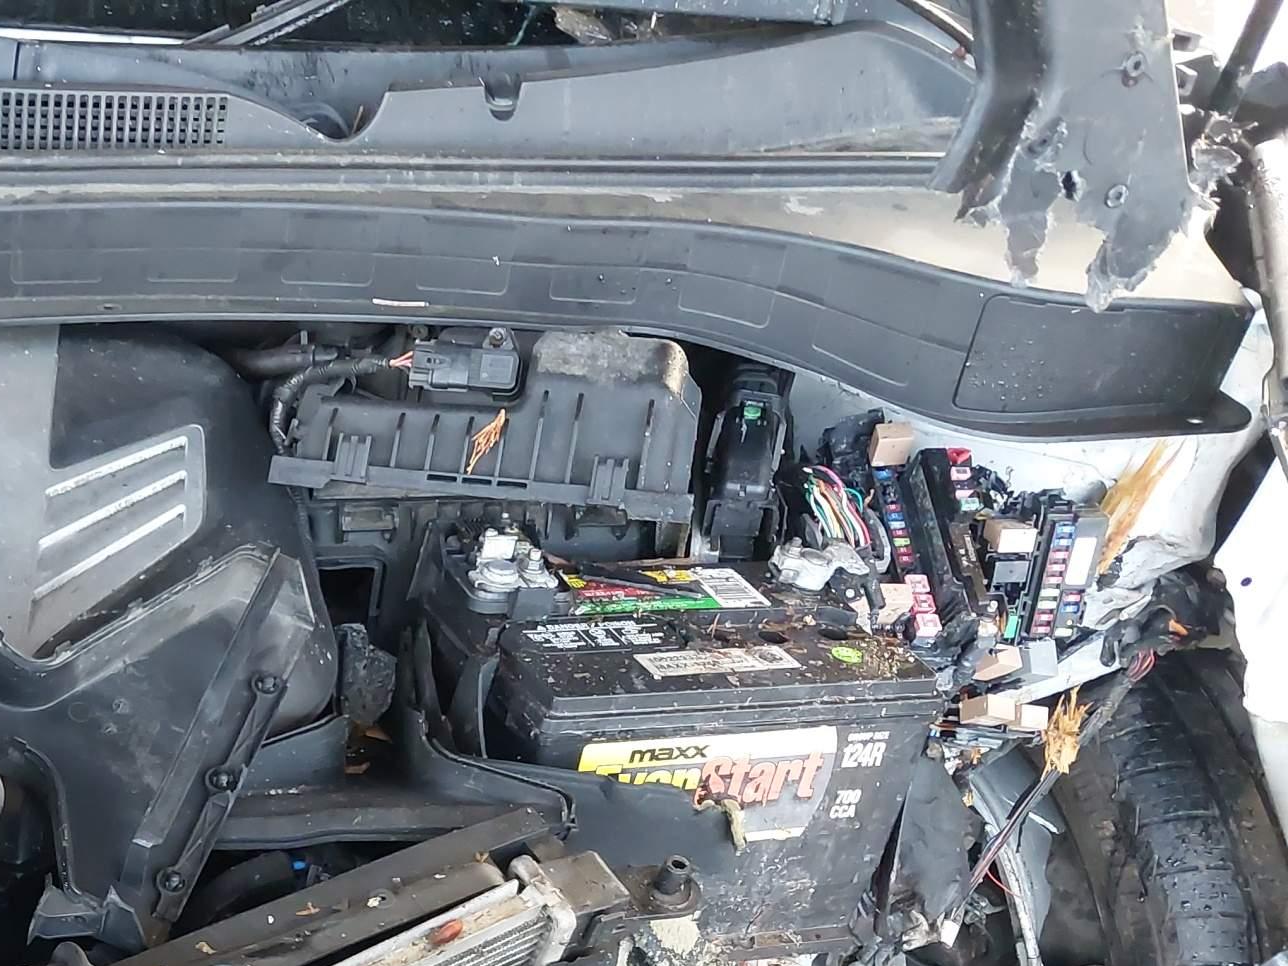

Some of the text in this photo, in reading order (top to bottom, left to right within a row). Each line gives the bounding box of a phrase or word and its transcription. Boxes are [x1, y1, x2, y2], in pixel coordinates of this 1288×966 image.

[629, 744, 710, 764] maxx
[841, 741, 886, 768] 124R
[835, 788, 862, 805] 700
[829, 804, 856, 819] CCA
